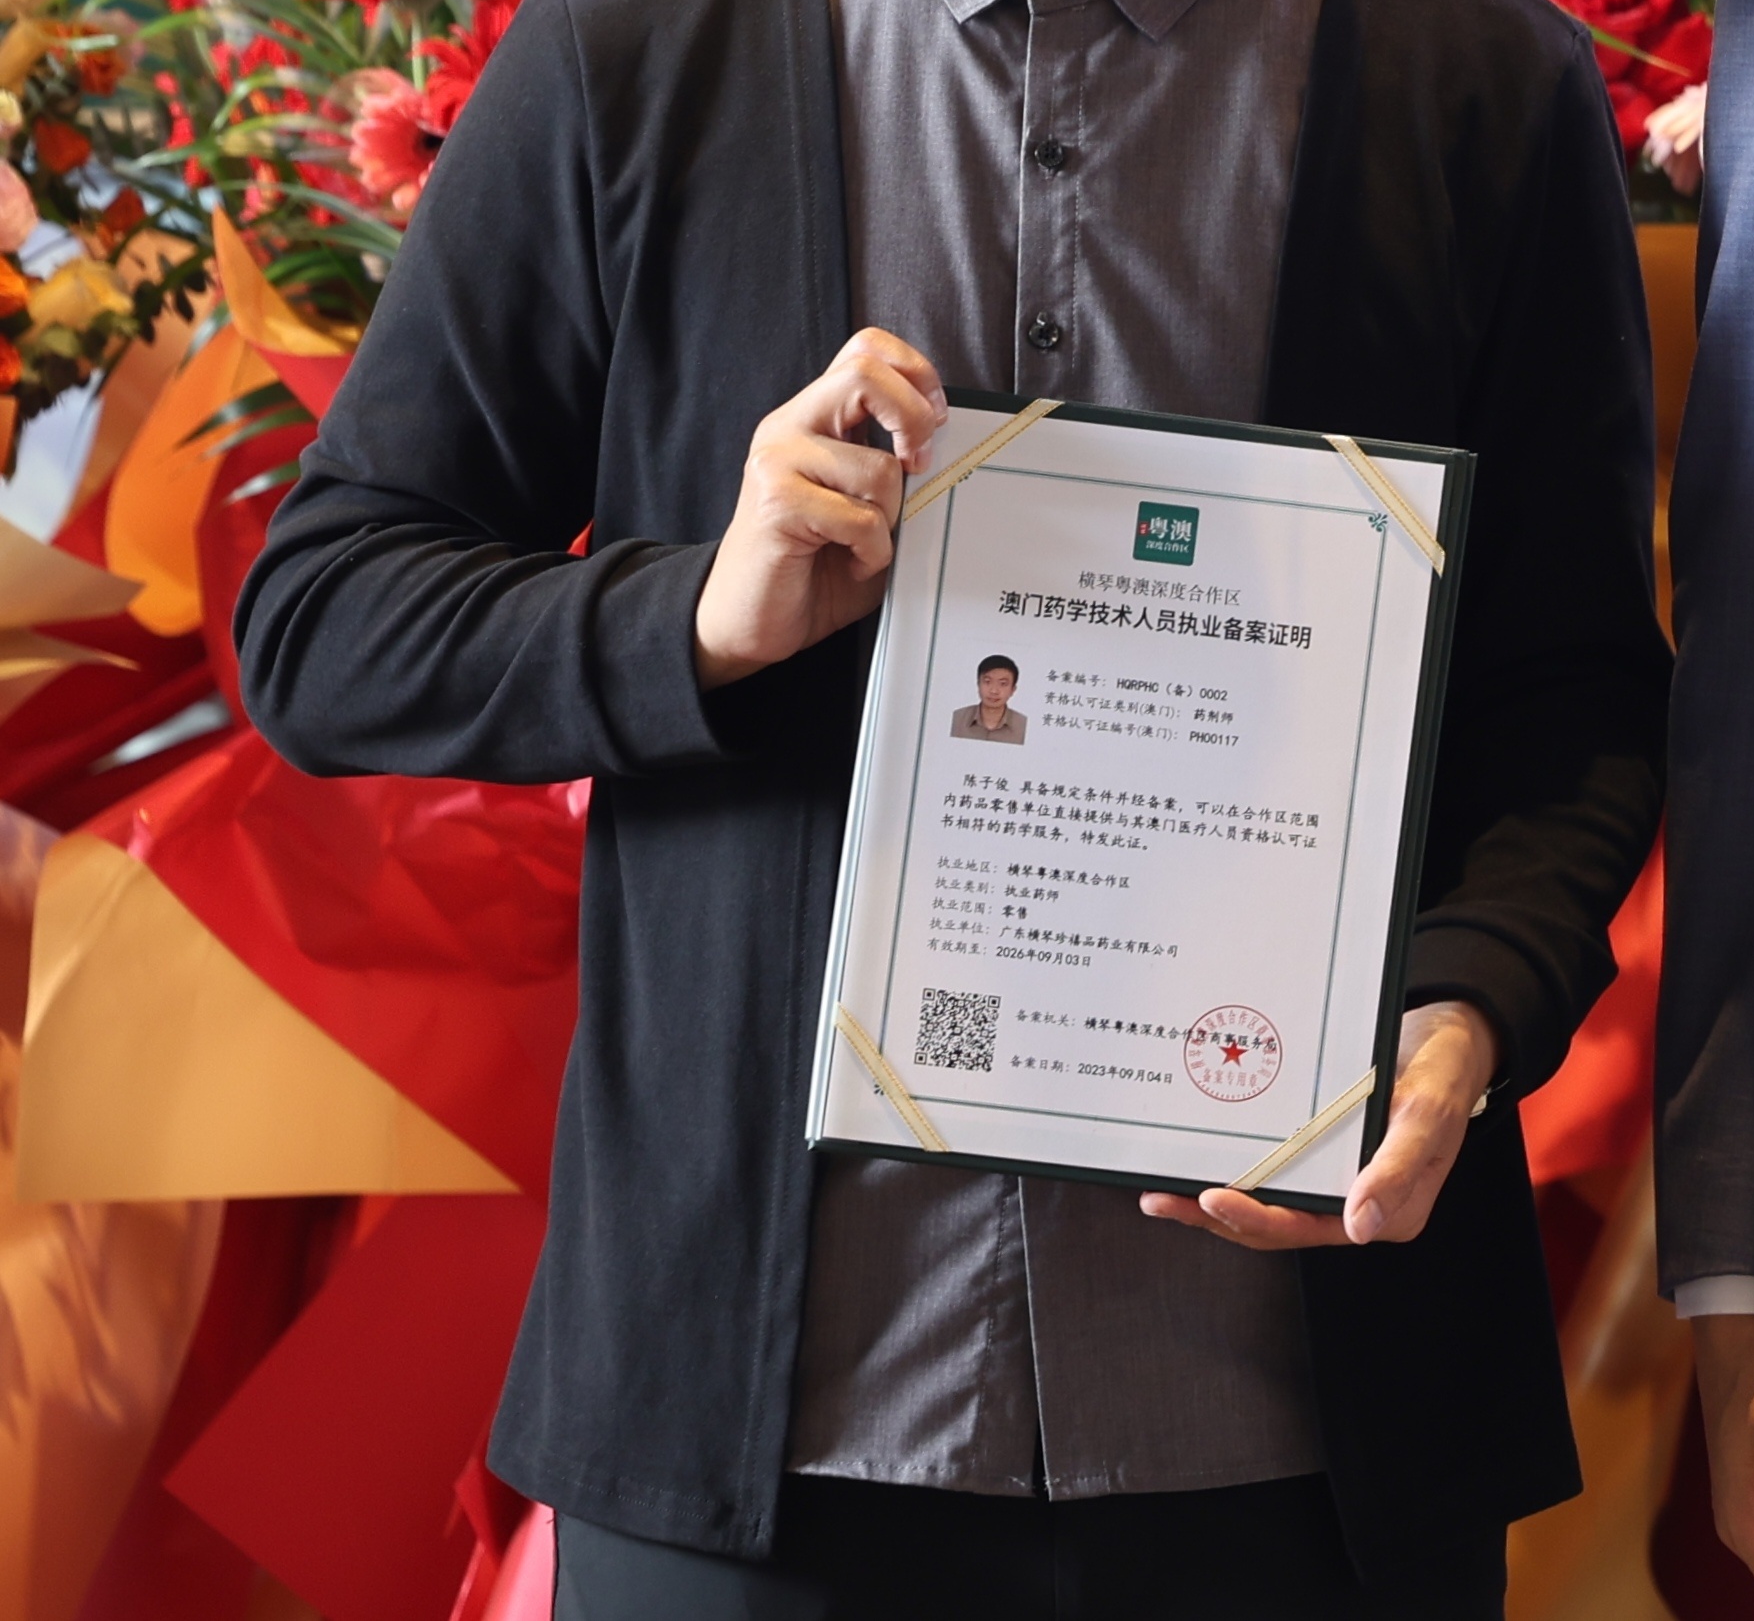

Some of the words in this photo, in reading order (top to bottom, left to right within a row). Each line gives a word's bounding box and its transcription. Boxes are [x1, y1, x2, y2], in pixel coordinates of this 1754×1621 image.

[1147, 517, 1192, 543] 粤澳
[1077, 570, 1241, 606] 横琴粤澳深度合作区
[998, 589, 1312, 650] 澳门药学技术人员执业备案证明
[1193, 708, 1234, 725] 药剂师
[1188, 730, 1240, 747] PH00117
[963, 773, 1010, 792] 陈子俊
[941, 813, 1148, 851] 书相符的药学服务，特发此证。
[1007, 863, 1129, 889] 横琴粤澳深度合作区
[1004, 884, 1059, 902] 执业药师
[1002, 904, 1027, 920] 零售
[995, 945, 1091, 968] 2026年09月03日
[1077, 1062, 1173, 1085] 2023年09月04日
